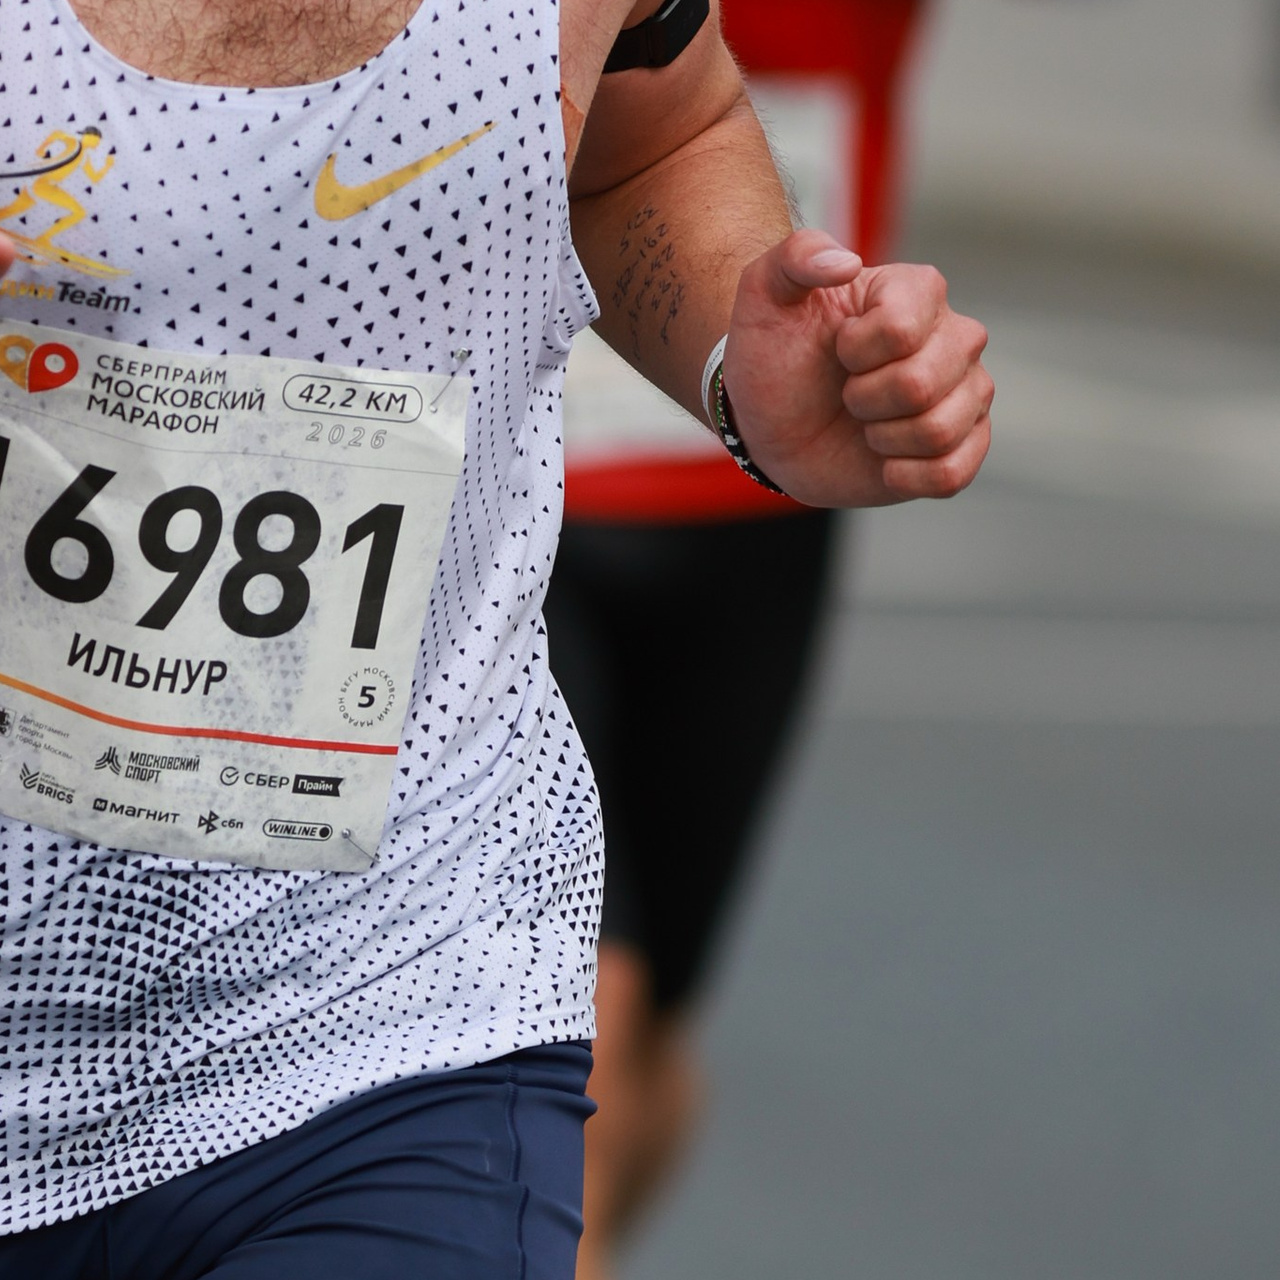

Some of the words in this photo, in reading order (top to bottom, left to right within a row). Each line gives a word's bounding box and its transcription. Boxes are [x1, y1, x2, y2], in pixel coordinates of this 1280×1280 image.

[57, 281, 131, 313] Team
[96, 354, 227, 385] СБЕРПРАЙМ
[91, 372, 265, 411] МОСКОВСКИЙ
[298, 383, 357, 409] 42,2
[86, 394, 219, 434] МАРАФОН
[305, 421, 387, 449] 2026
[66, 632, 228, 697] ИЛЬНУР
[357, 685, 377, 708] 5
[125, 765, 161, 784] СПОРТ
[128, 751, 200, 772] МОСКОВСКИЙ
[37, 783, 74, 805] BRICS
[244, 772, 290, 789] СБЕР
[297, 778, 333, 792] Прайм
[268, 823, 318, 837] WINLINE
